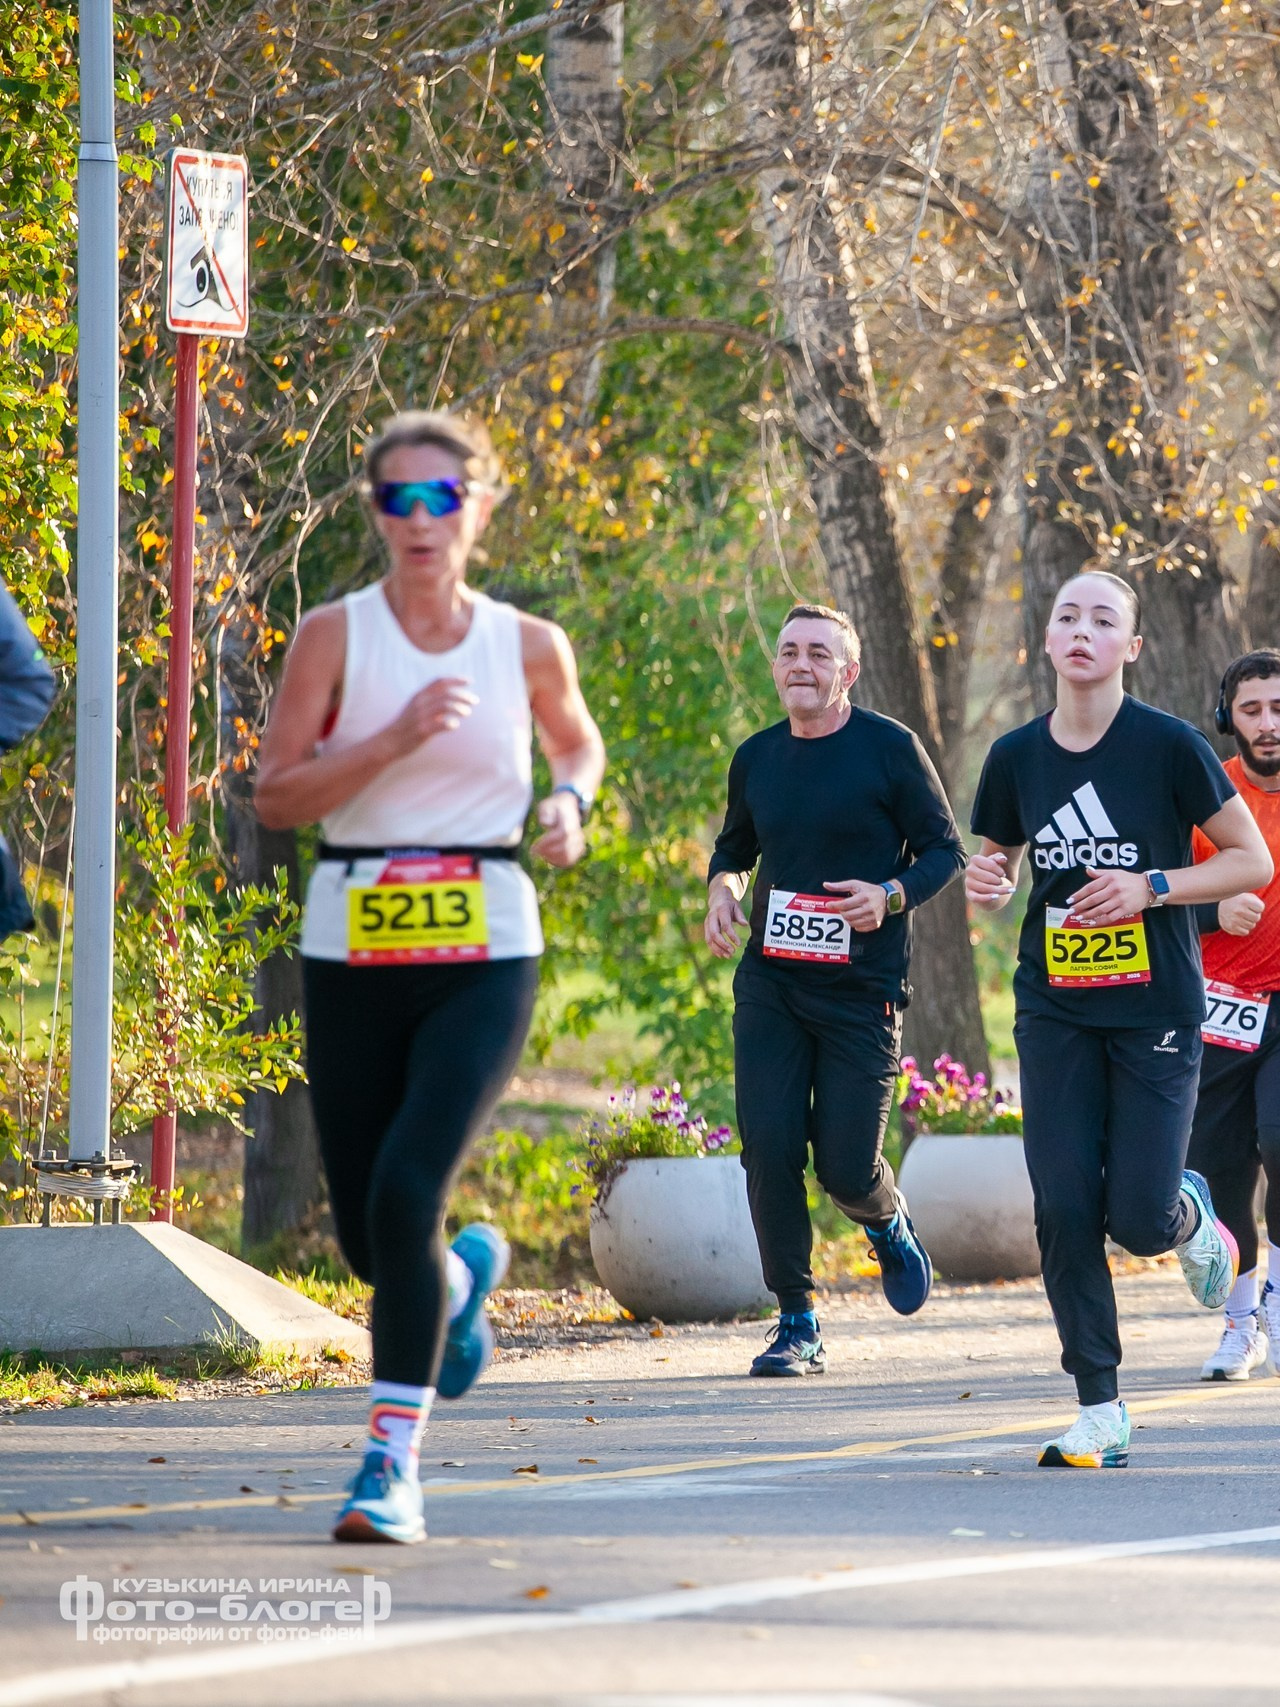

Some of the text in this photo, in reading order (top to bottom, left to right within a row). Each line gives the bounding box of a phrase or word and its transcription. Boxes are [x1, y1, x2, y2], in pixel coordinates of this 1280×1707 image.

[186, 176, 232, 200] КУПТЬЯ
[179, 205, 239, 231] ЗАПРЕНО!
[1035, 836, 1139, 870] adidas
[360, 890, 471, 932] 5213
[770, 912, 844, 944] 5852
[1052, 930, 1138, 963] 5225
[1094, 963, 1119, 971] СОФИЯ
